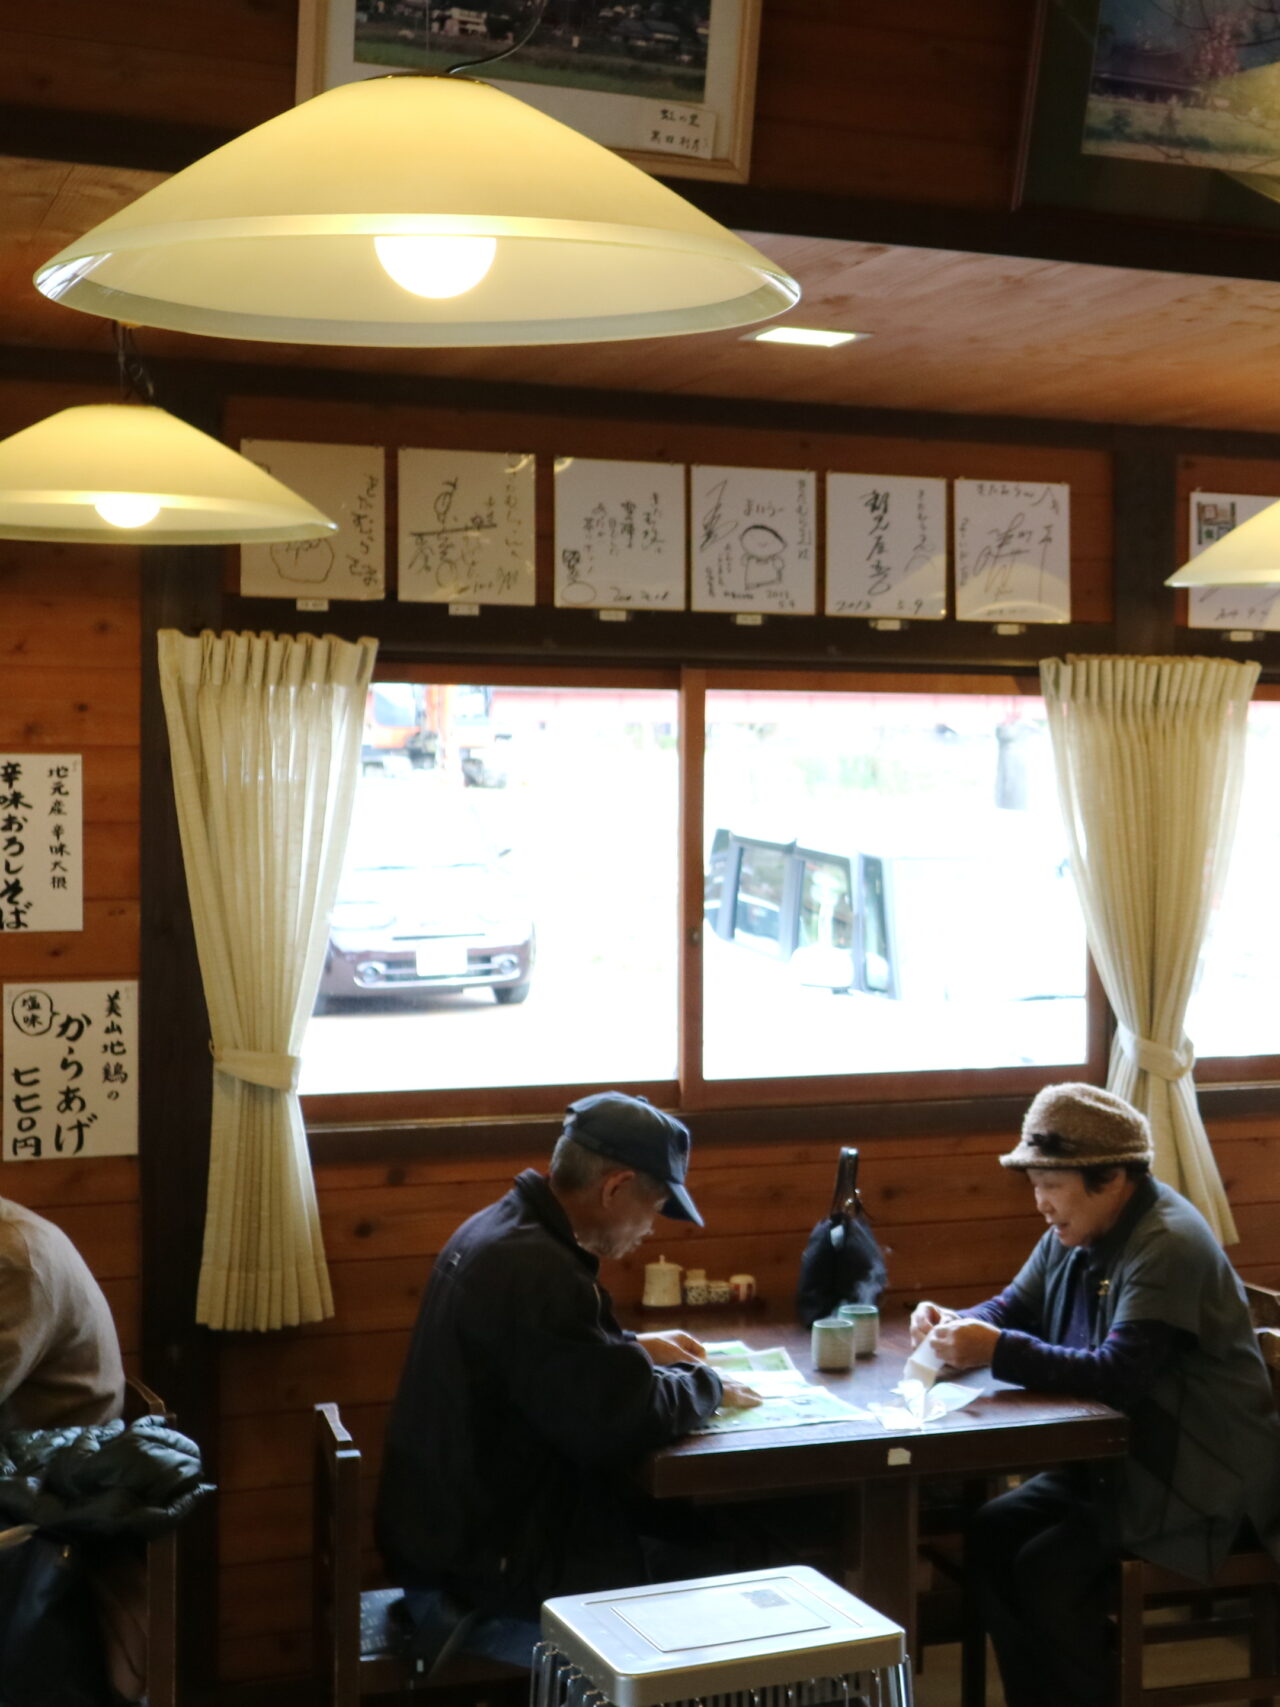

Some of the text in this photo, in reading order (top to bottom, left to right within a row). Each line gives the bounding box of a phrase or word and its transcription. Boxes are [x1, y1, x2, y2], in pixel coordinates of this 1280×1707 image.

[21, 995, 43, 1029] 塩味
[101, 990, 128, 1101] 美山地鶏の
[55, 1013, 98, 1156] からあげ
